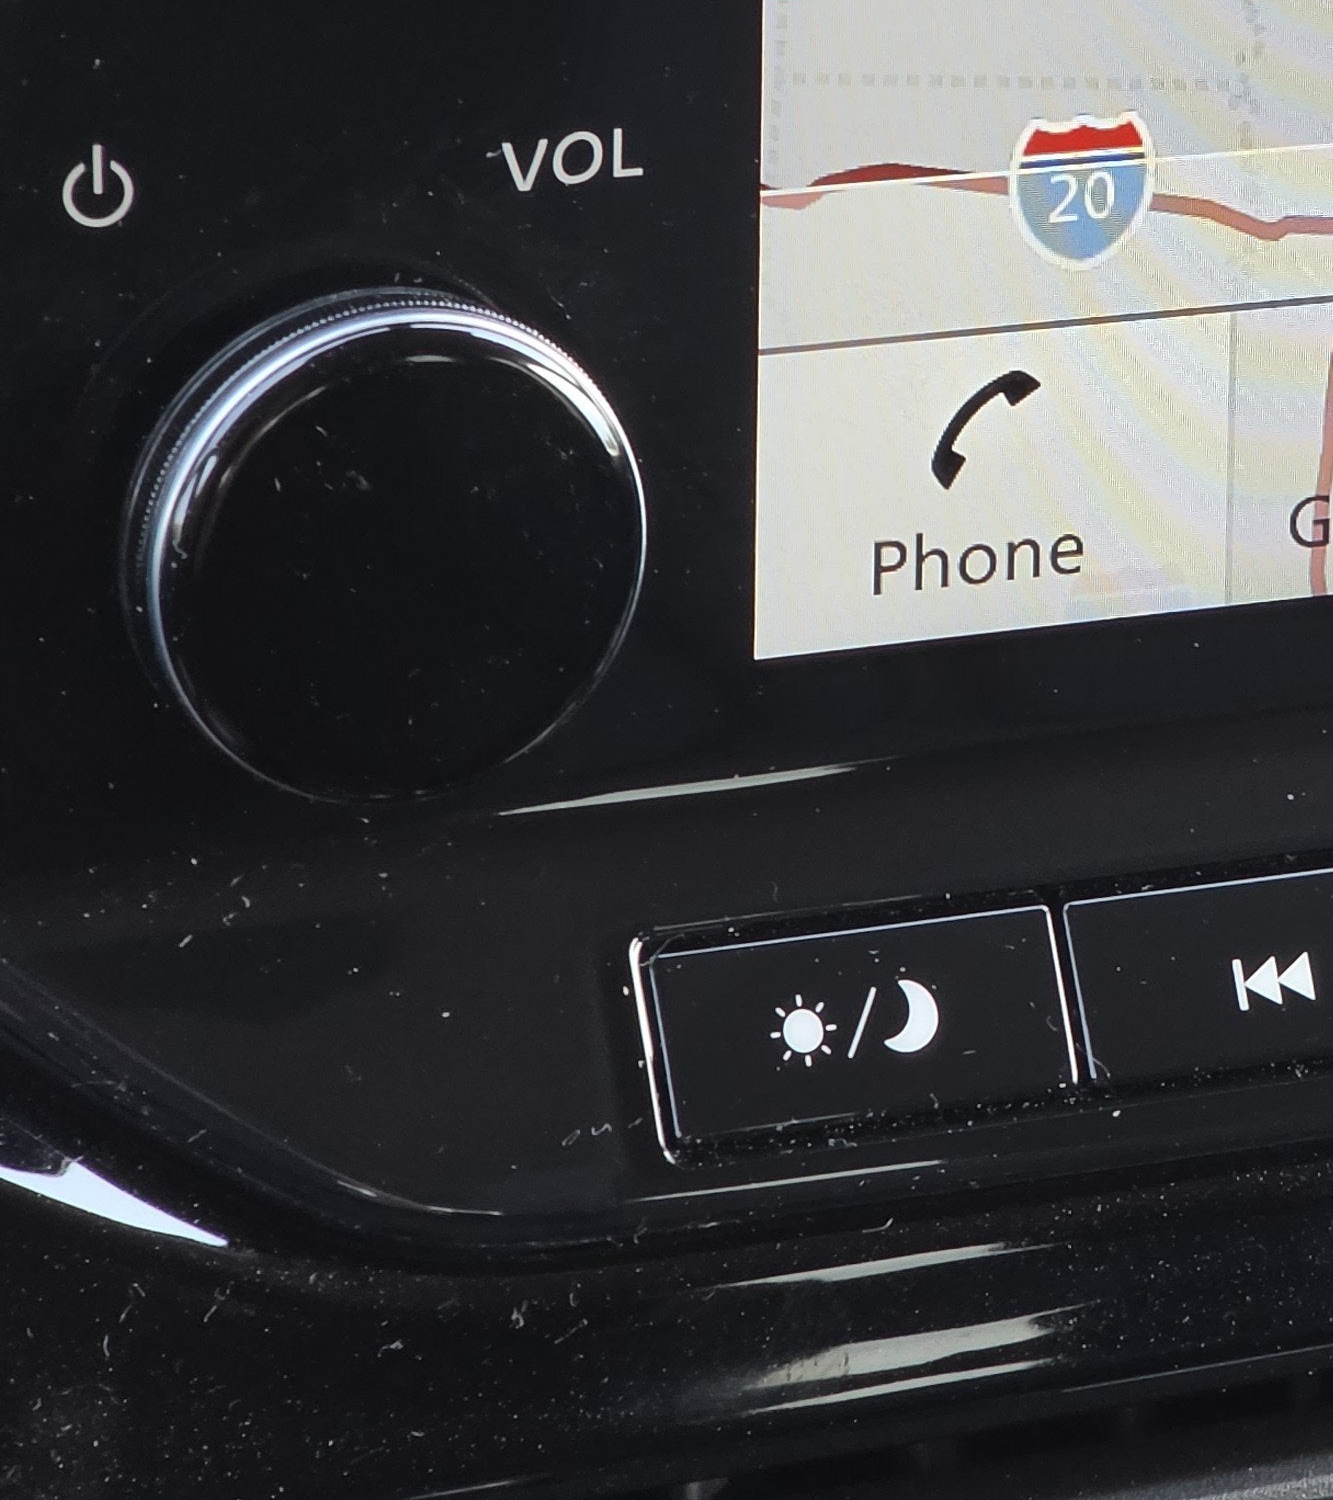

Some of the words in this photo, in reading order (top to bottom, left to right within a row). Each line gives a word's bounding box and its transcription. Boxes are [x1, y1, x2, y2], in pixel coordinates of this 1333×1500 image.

[501, 127, 644, 192] VOL
[1047, 170, 1117, 224] 20
[871, 530, 1085, 596] Phone
